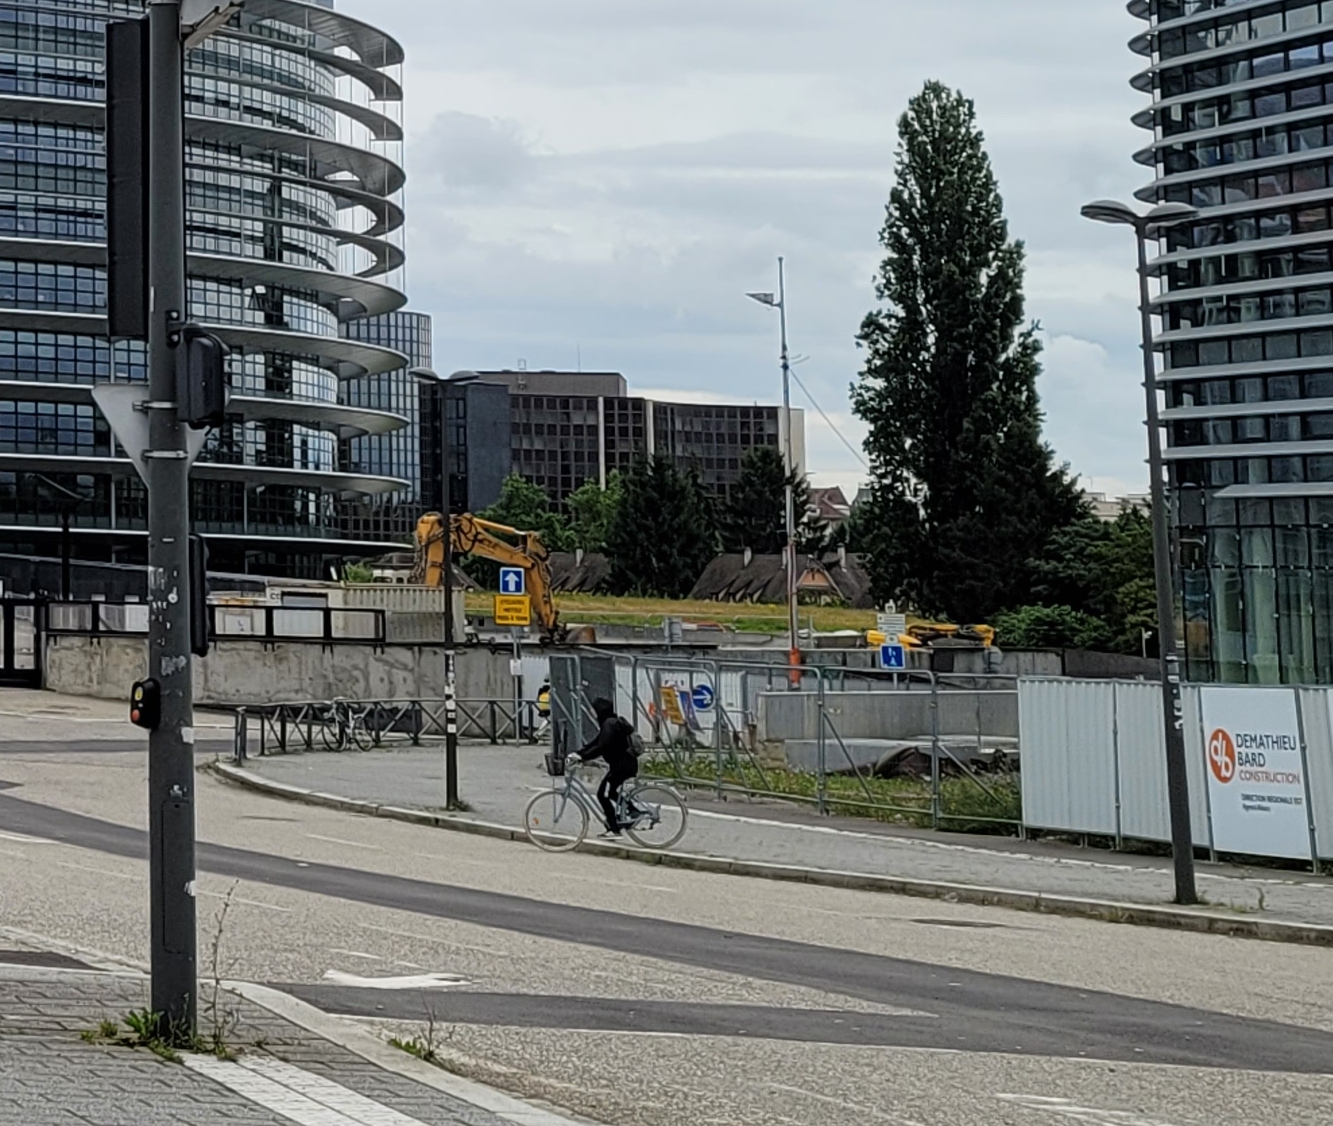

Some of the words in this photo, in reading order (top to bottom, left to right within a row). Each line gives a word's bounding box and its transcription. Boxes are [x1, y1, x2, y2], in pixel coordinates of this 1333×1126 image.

[1235, 733, 1296, 751] DEMATHIEU
[1237, 751, 1266, 768] BARD
[1239, 769, 1301, 785] CONSTRUCTION
